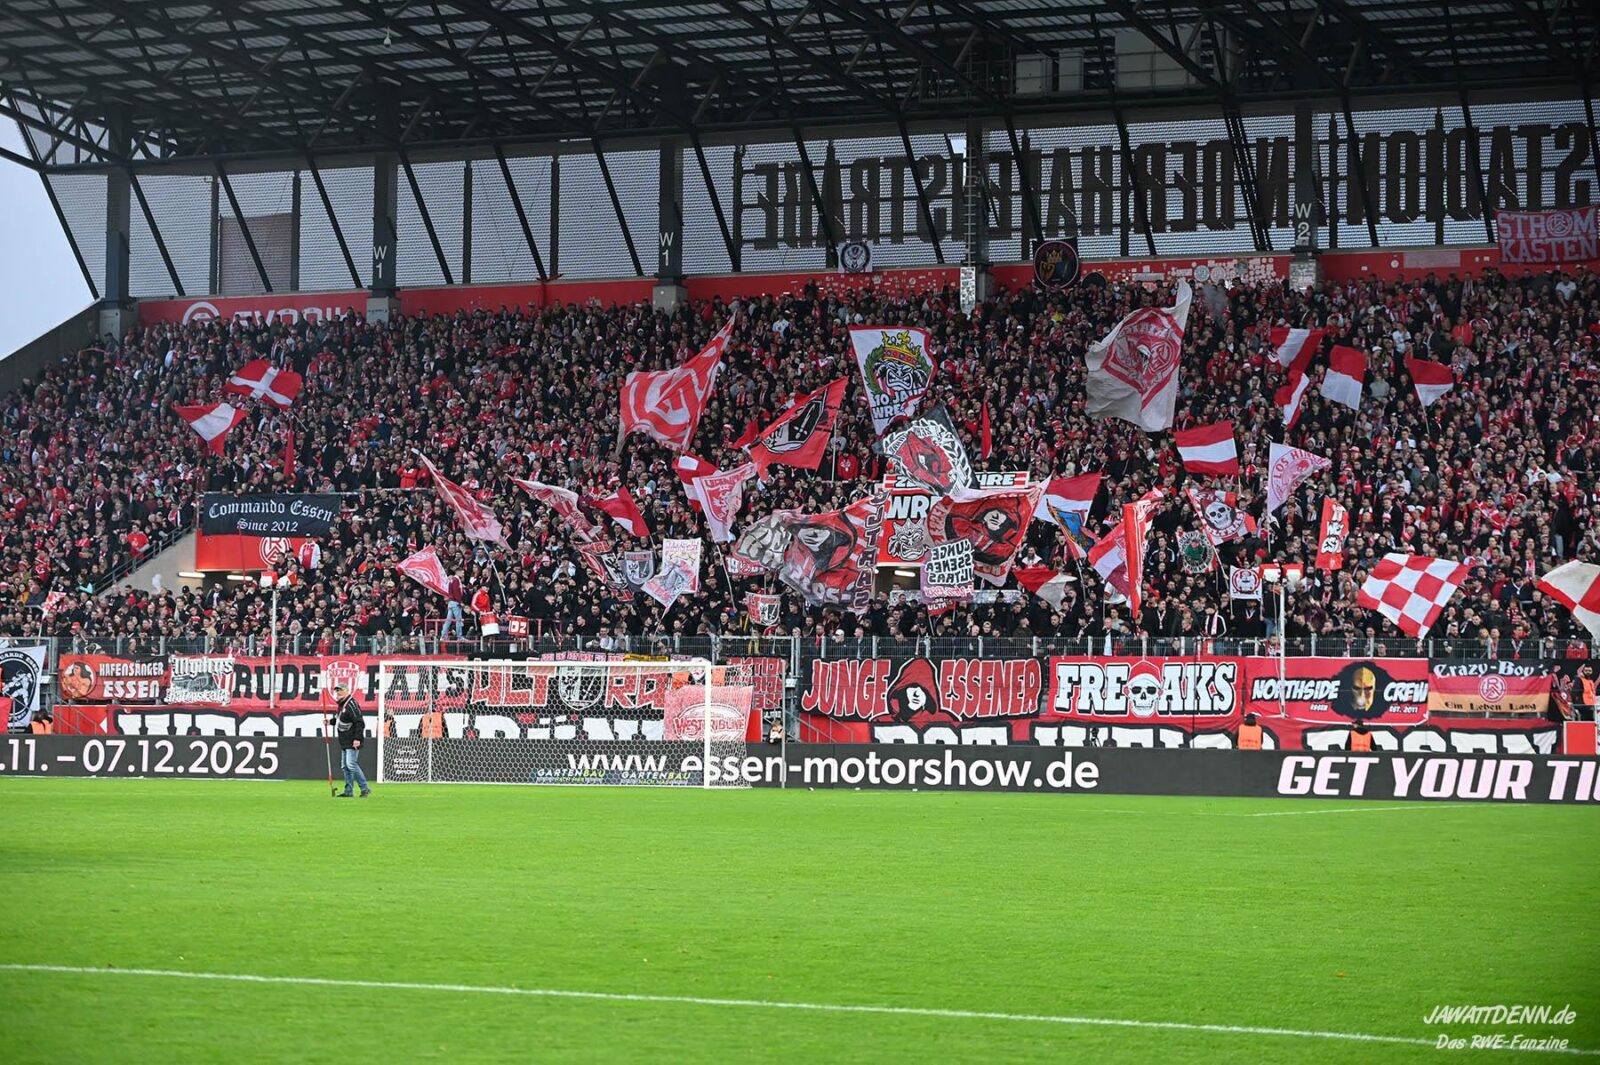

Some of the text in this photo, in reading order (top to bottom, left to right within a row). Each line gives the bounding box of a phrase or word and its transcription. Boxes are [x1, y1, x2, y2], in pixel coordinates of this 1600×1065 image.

[1295, 202, 1312, 239] W 2
[373, 245, 387, 278] W 1
[660, 232, 674, 266] W 1
[1502, 237, 1598, 263] KASTEN
[209, 500, 333, 522] Commando Essen
[236, 518, 298, 532] Since 2012
[99, 660, 164, 677] HAFENSÄNGER
[233, 664, 321, 701] RUDE
[103, 680, 160, 698] ESSEN
[801, 658, 1042, 718] JUNGE ESSENER
[1054, 662, 1237, 716] FREAKS
[1251, 678, 1429, 703] NORTHSIDE CREW
[1444, 701, 1464, 711] Ein
[1469, 702, 1502, 712] Leben
[82, 739, 280, 775] 07.12.2025
[1277, 755, 1600, 801] GET YOUR TI
